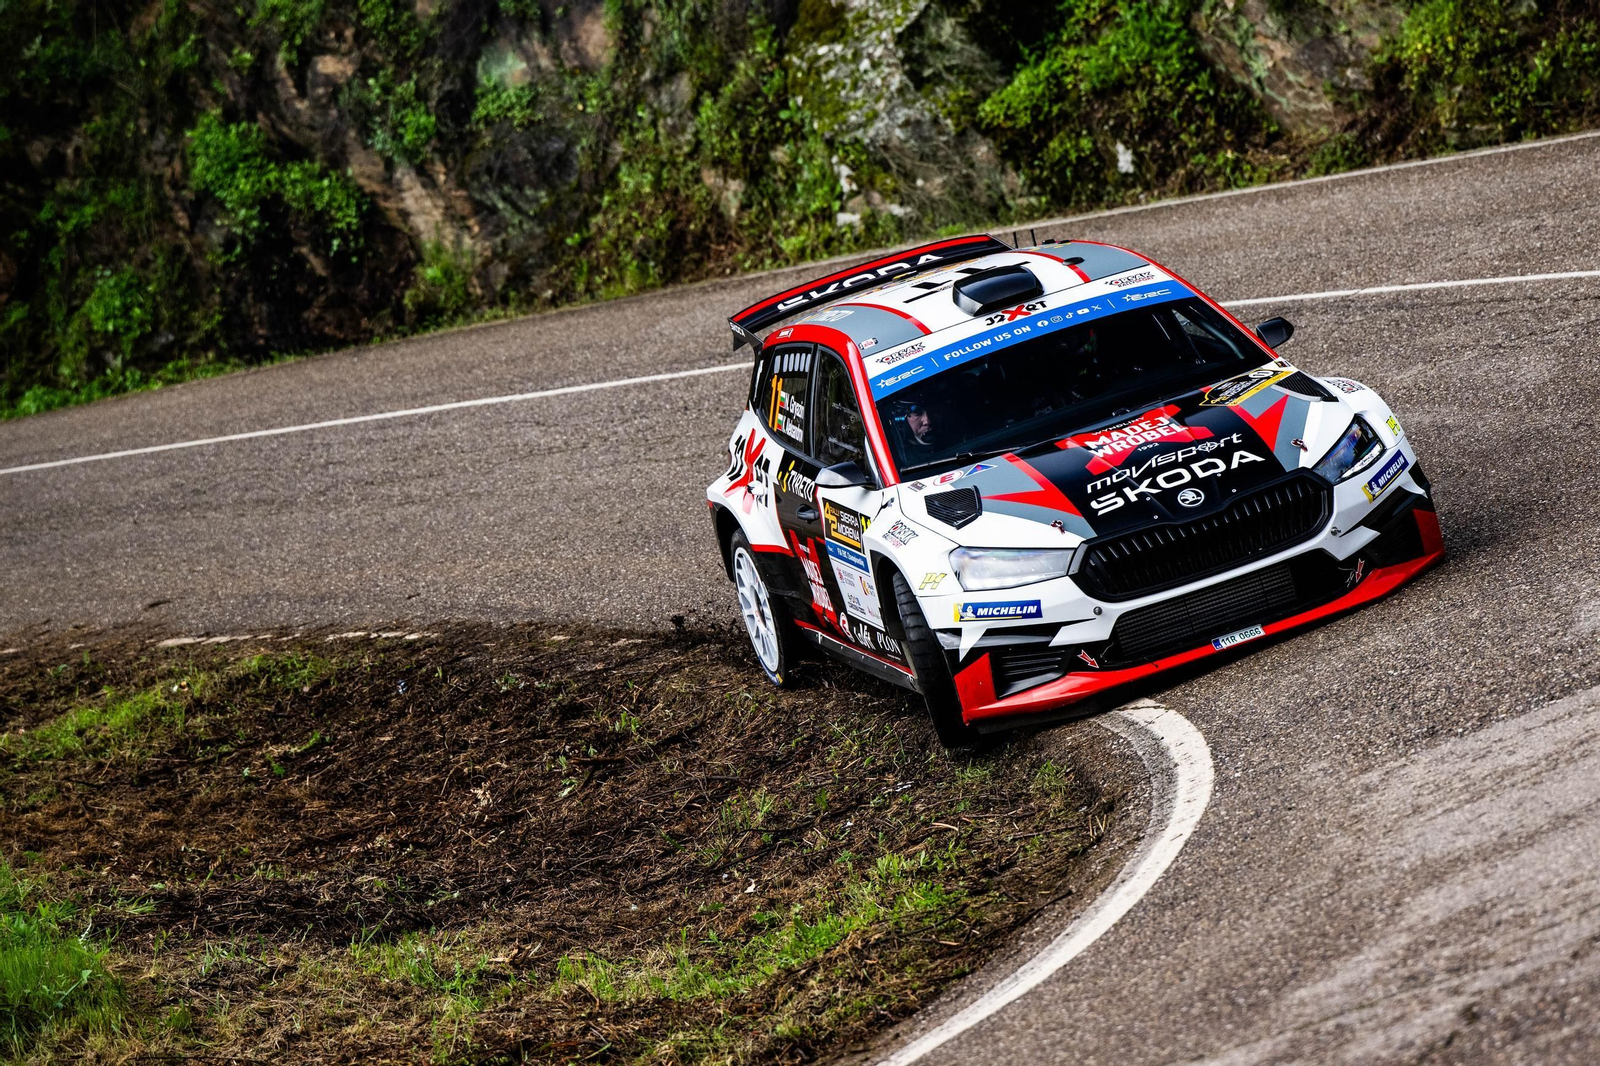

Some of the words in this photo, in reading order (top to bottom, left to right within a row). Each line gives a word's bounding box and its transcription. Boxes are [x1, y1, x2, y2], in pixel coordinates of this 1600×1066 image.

[944, 338, 992, 361] FOLLOW
[995, 332, 1012, 343] US
[1013, 325, 1032, 336] ON
[1084, 416, 1170, 450] MADEJ
[1090, 450, 1266, 516] SKODA
[1378, 454, 1405, 487] MICHELIN
[838, 522, 861, 541] MORENA
[840, 510, 860, 528] SIERRA
[976, 605, 1038, 616] MICHELIN
[1221, 635, 1237, 646] 11R
[1238, 627, 1261, 640] 0666
